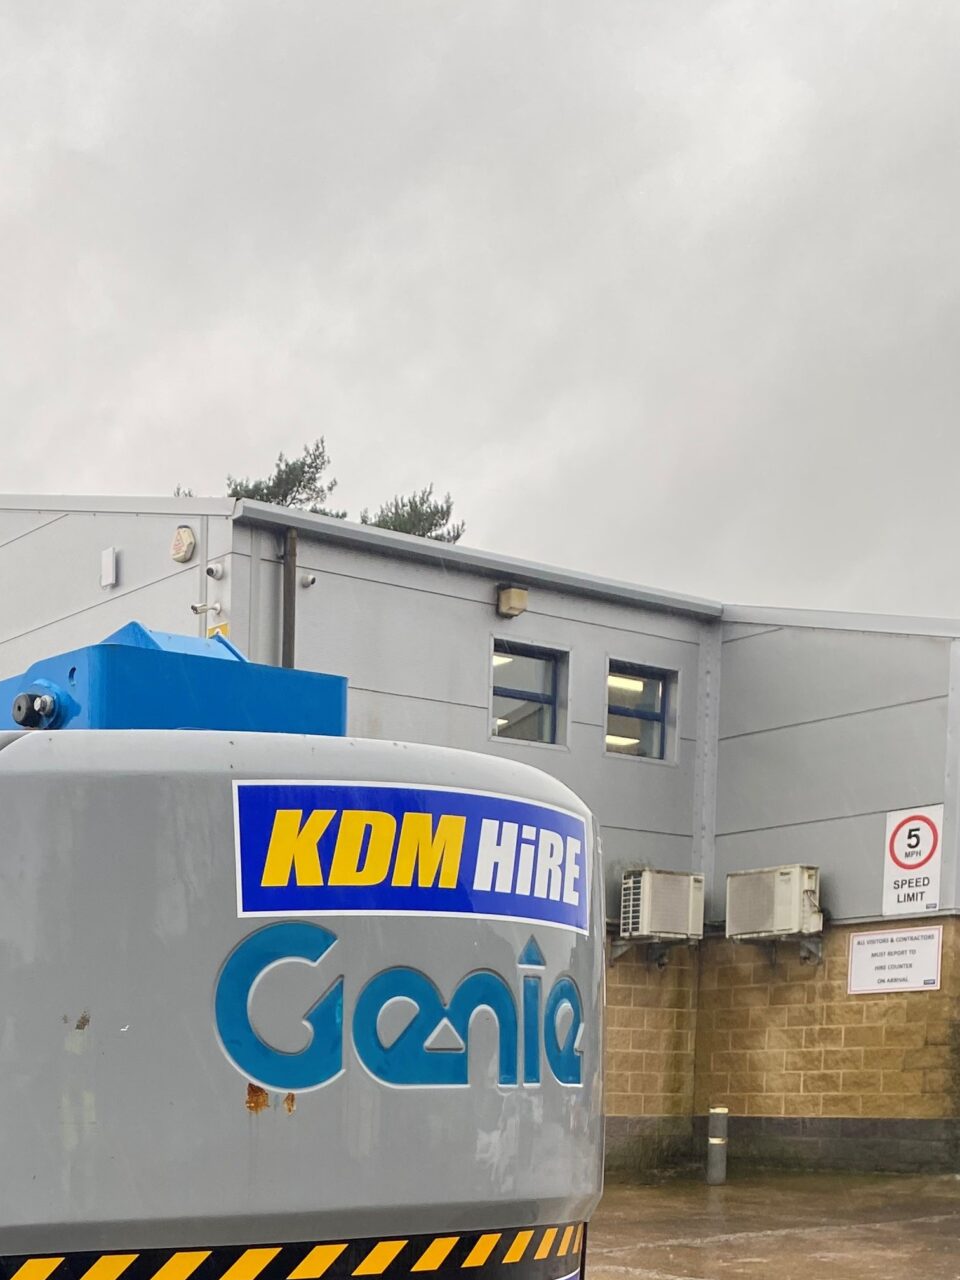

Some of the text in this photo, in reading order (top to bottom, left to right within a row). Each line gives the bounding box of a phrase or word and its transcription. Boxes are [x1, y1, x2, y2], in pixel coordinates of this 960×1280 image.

[906, 827, 921, 849] 5
[261, 809, 582, 906] KDM HiRE
[904, 850, 922, 858] MPH
[893, 876, 930, 890] SPEED
[897, 891, 925, 903] LIMIT
[214, 920, 584, 1092] Genie
